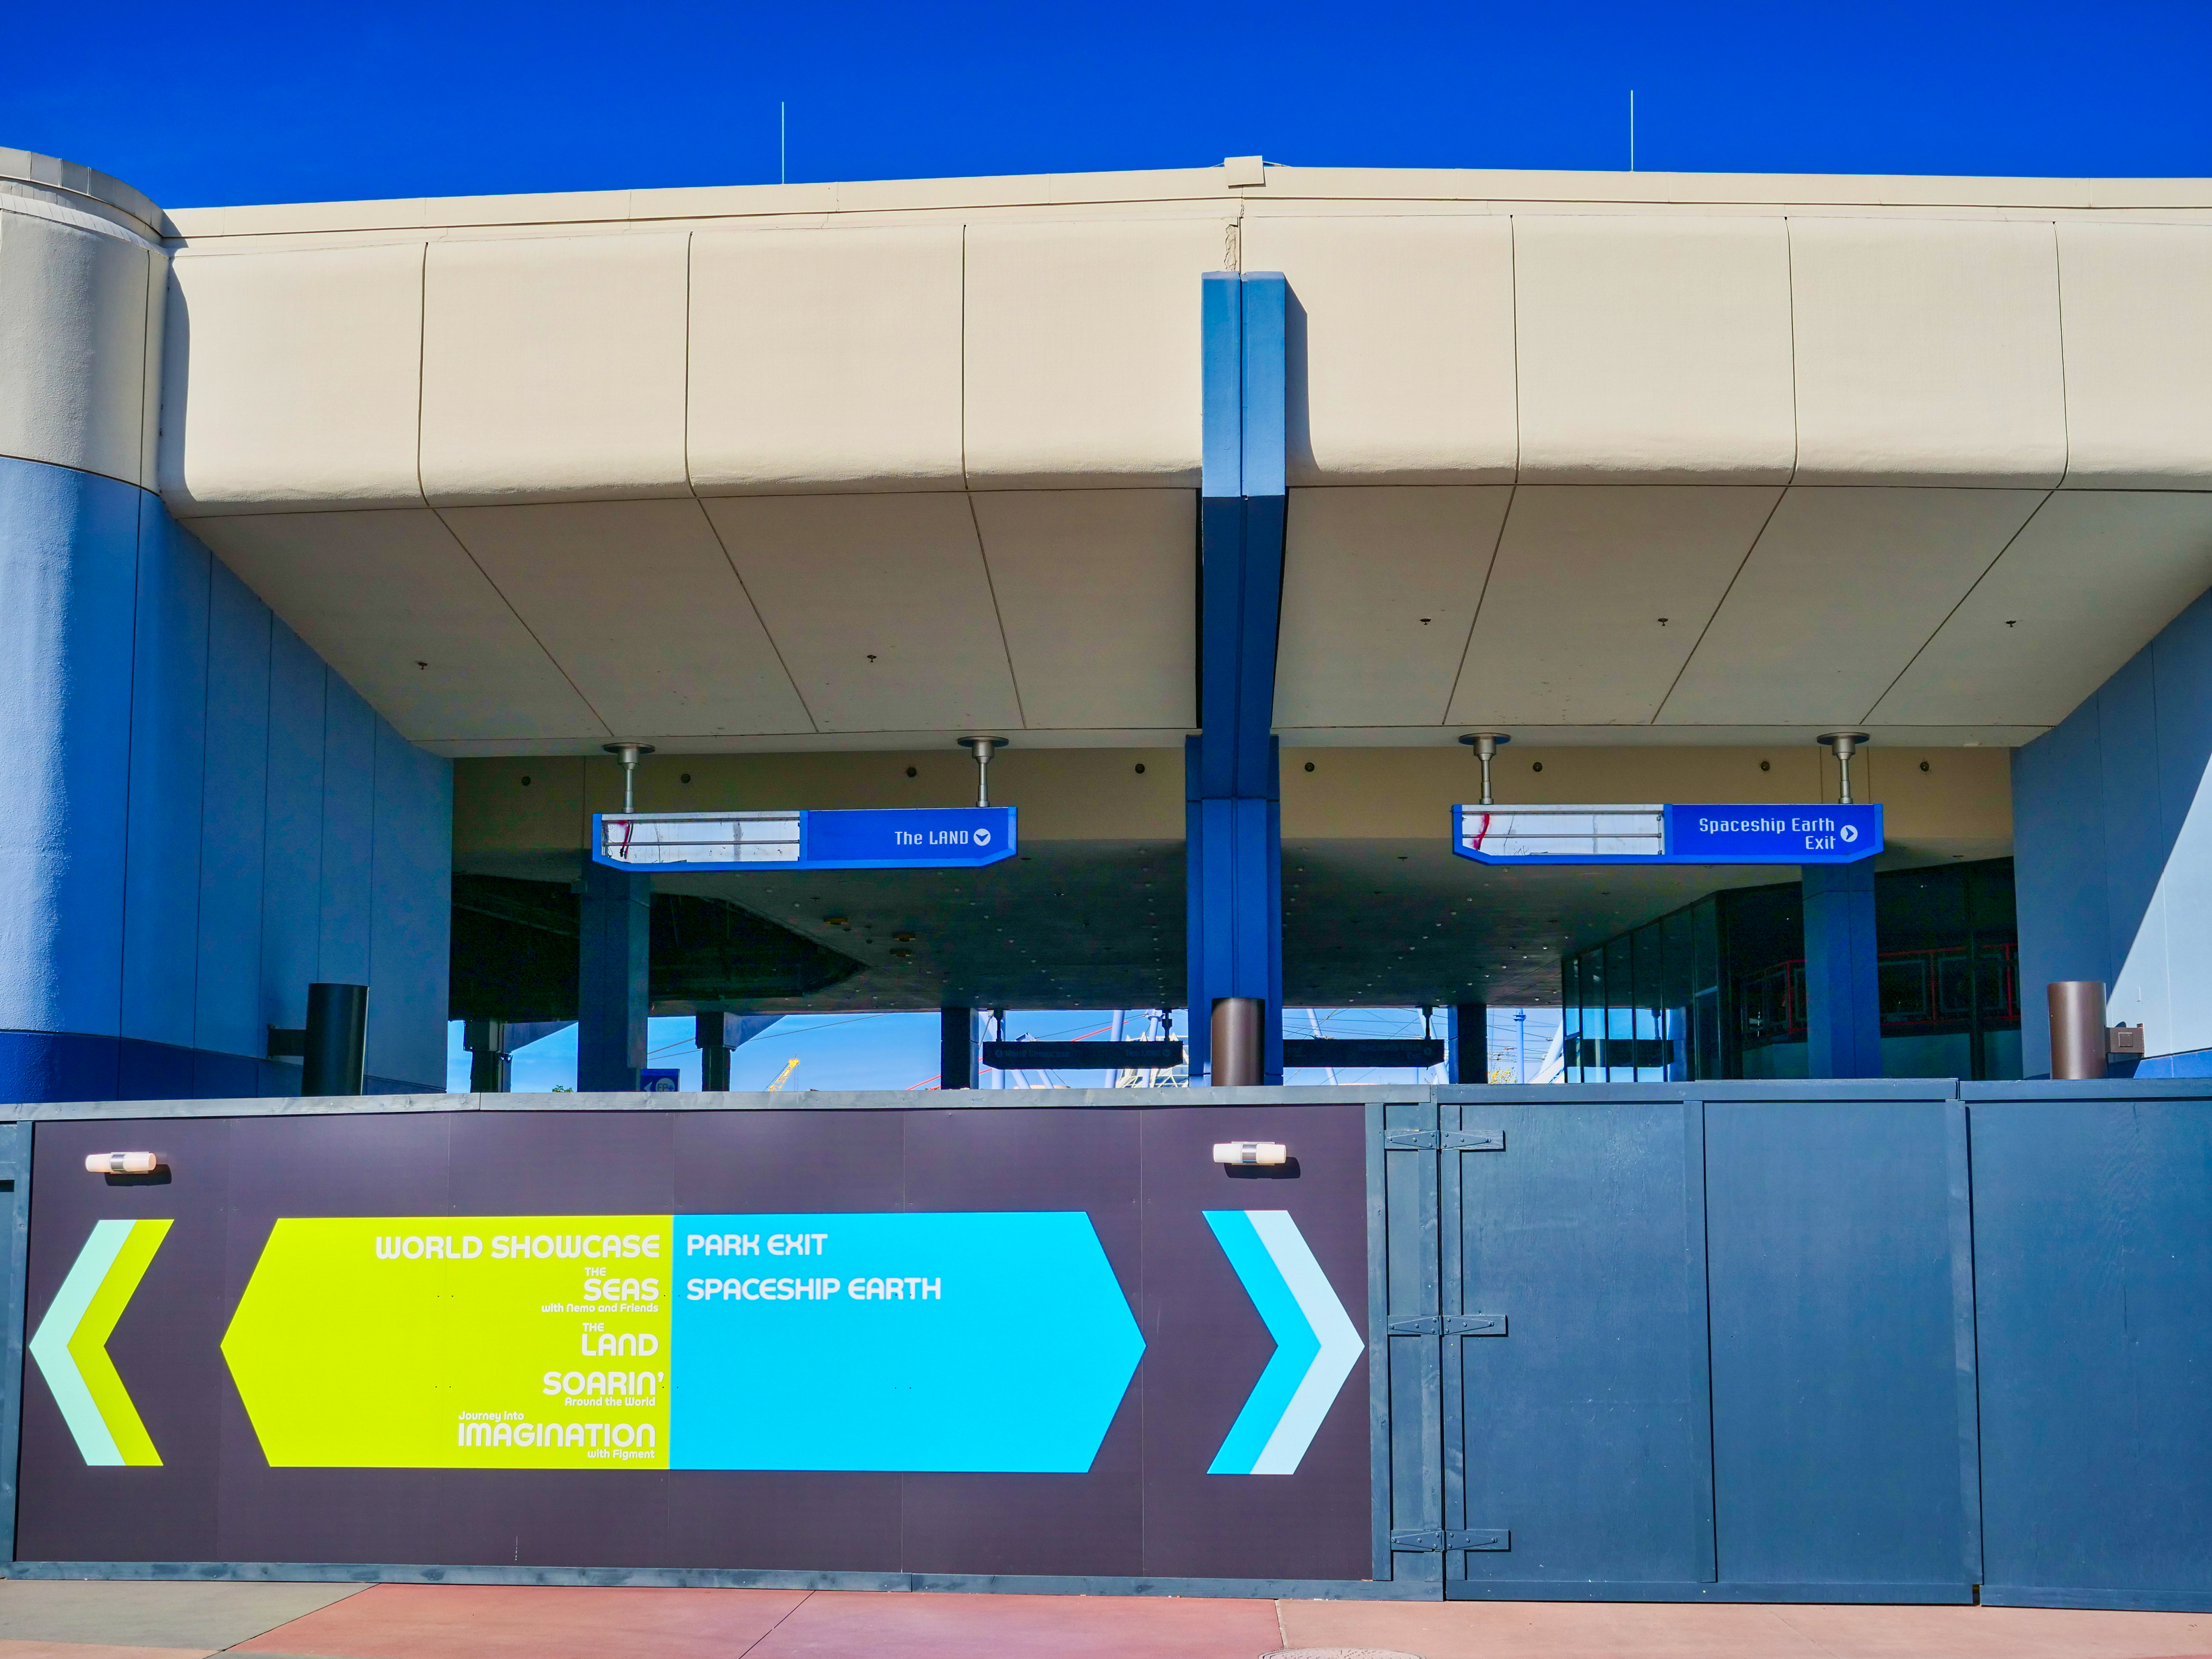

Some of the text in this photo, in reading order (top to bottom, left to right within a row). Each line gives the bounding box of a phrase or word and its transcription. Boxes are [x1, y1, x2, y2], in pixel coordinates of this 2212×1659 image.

[1700, 818, 1834, 834] Spaceship Earth
[895, 831, 968, 844] The LAND
[1806, 836, 1836, 849] Exit
[377, 1235, 660, 1259] WORLD SHOWCASE
[688, 1234, 828, 1256] PARK EXIT
[585, 1267, 606, 1276] THE
[584, 1278, 659, 1301] SEAS
[686, 1278, 940, 1300] SPACESHIP EARTH
[542, 1303, 658, 1312] with Nemo and Friends
[583, 1323, 604, 1331] THE
[582, 1334, 658, 1356] LAND
[543, 1372, 664, 1395] SOARIN'
[565, 1397, 655, 1406] Around the World
[459, 1411, 524, 1422] Journey into
[459, 1423, 655, 1447] IMAGINATION
[588, 1449, 655, 1460] with Figment
